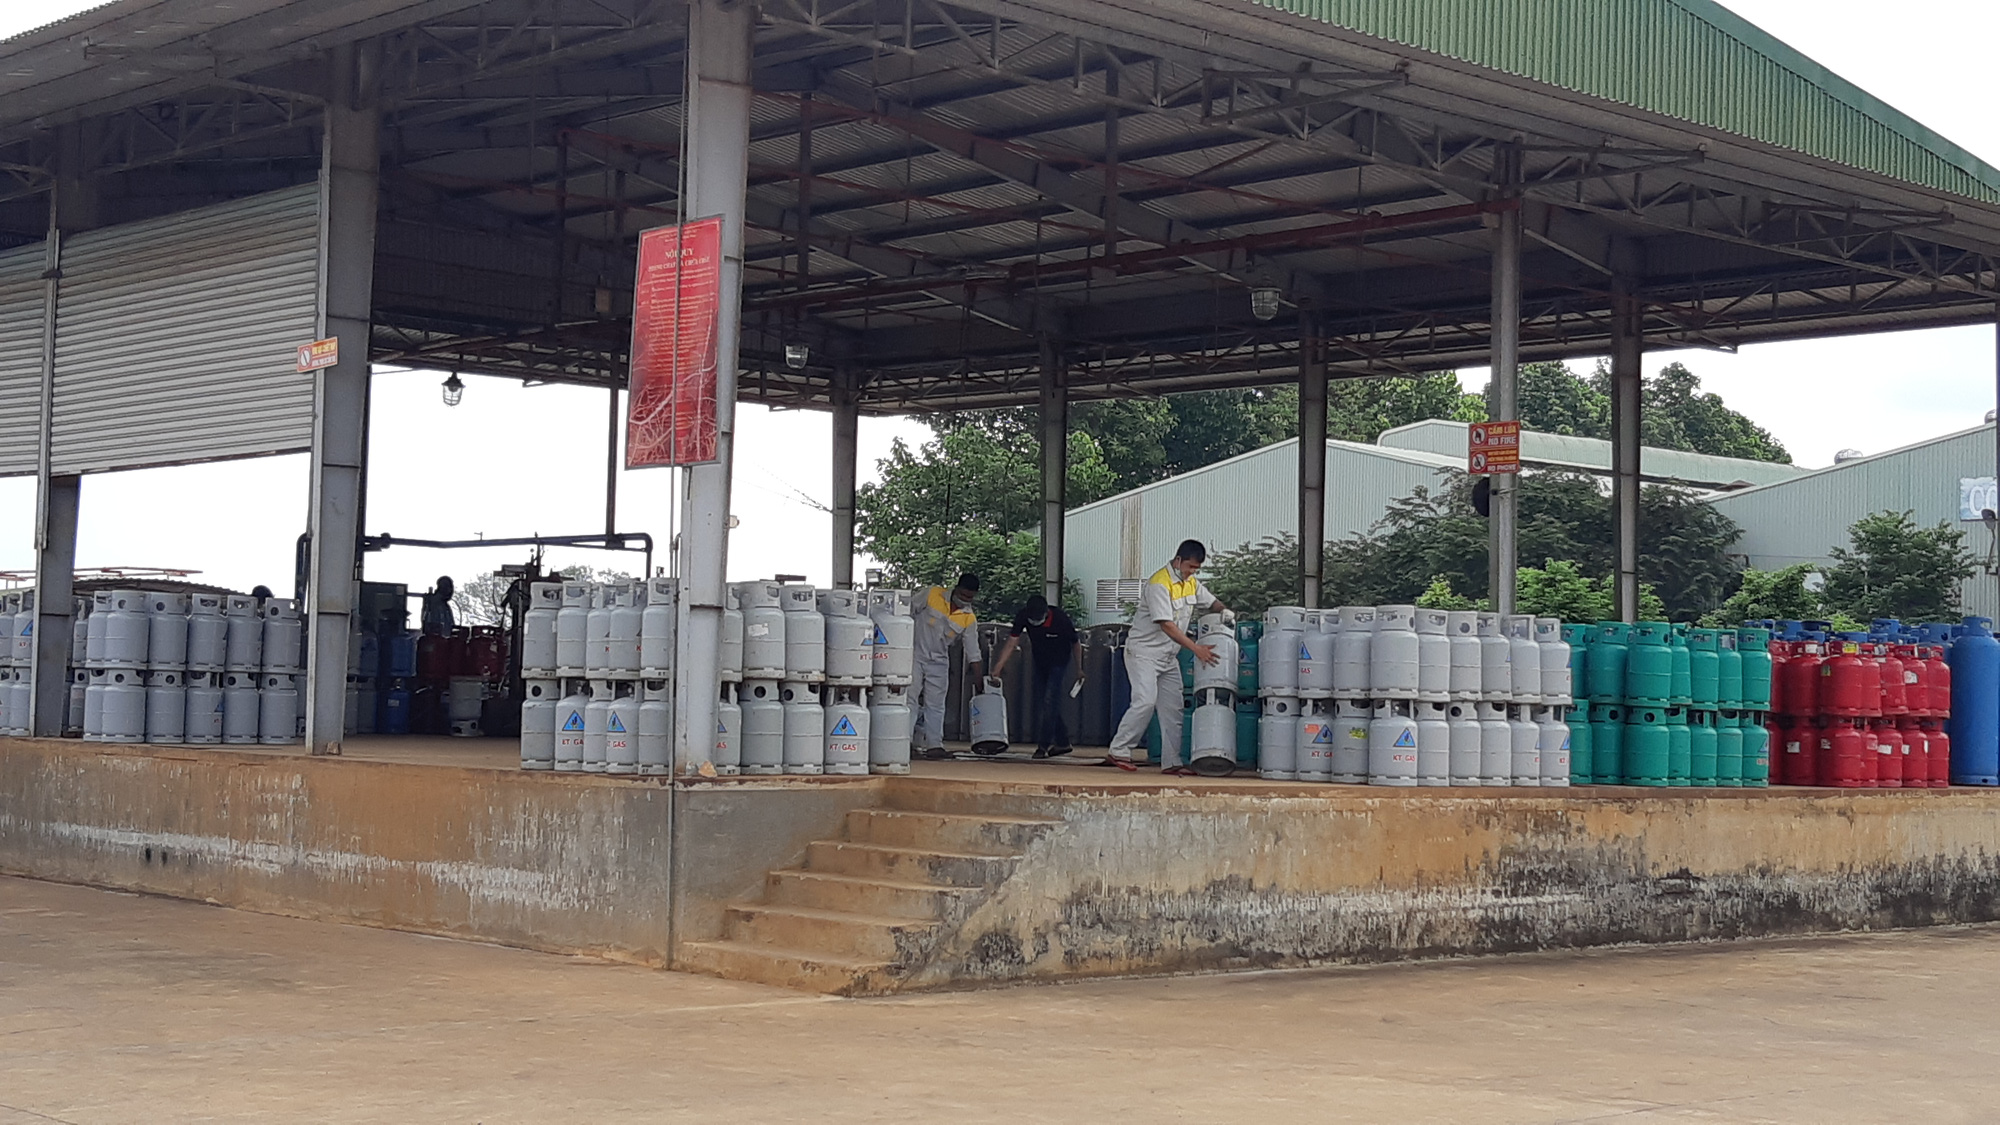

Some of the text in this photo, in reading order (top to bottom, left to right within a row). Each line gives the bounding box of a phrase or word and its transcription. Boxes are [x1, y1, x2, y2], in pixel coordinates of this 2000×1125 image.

[574, 738, 584, 746] GA
[613, 740, 627, 748] GAS
[716, 741, 727, 749] AS
[842, 743, 857, 751] GAS
[1311, 750, 1321, 758] KT
[1393, 754, 1402, 762] KT
